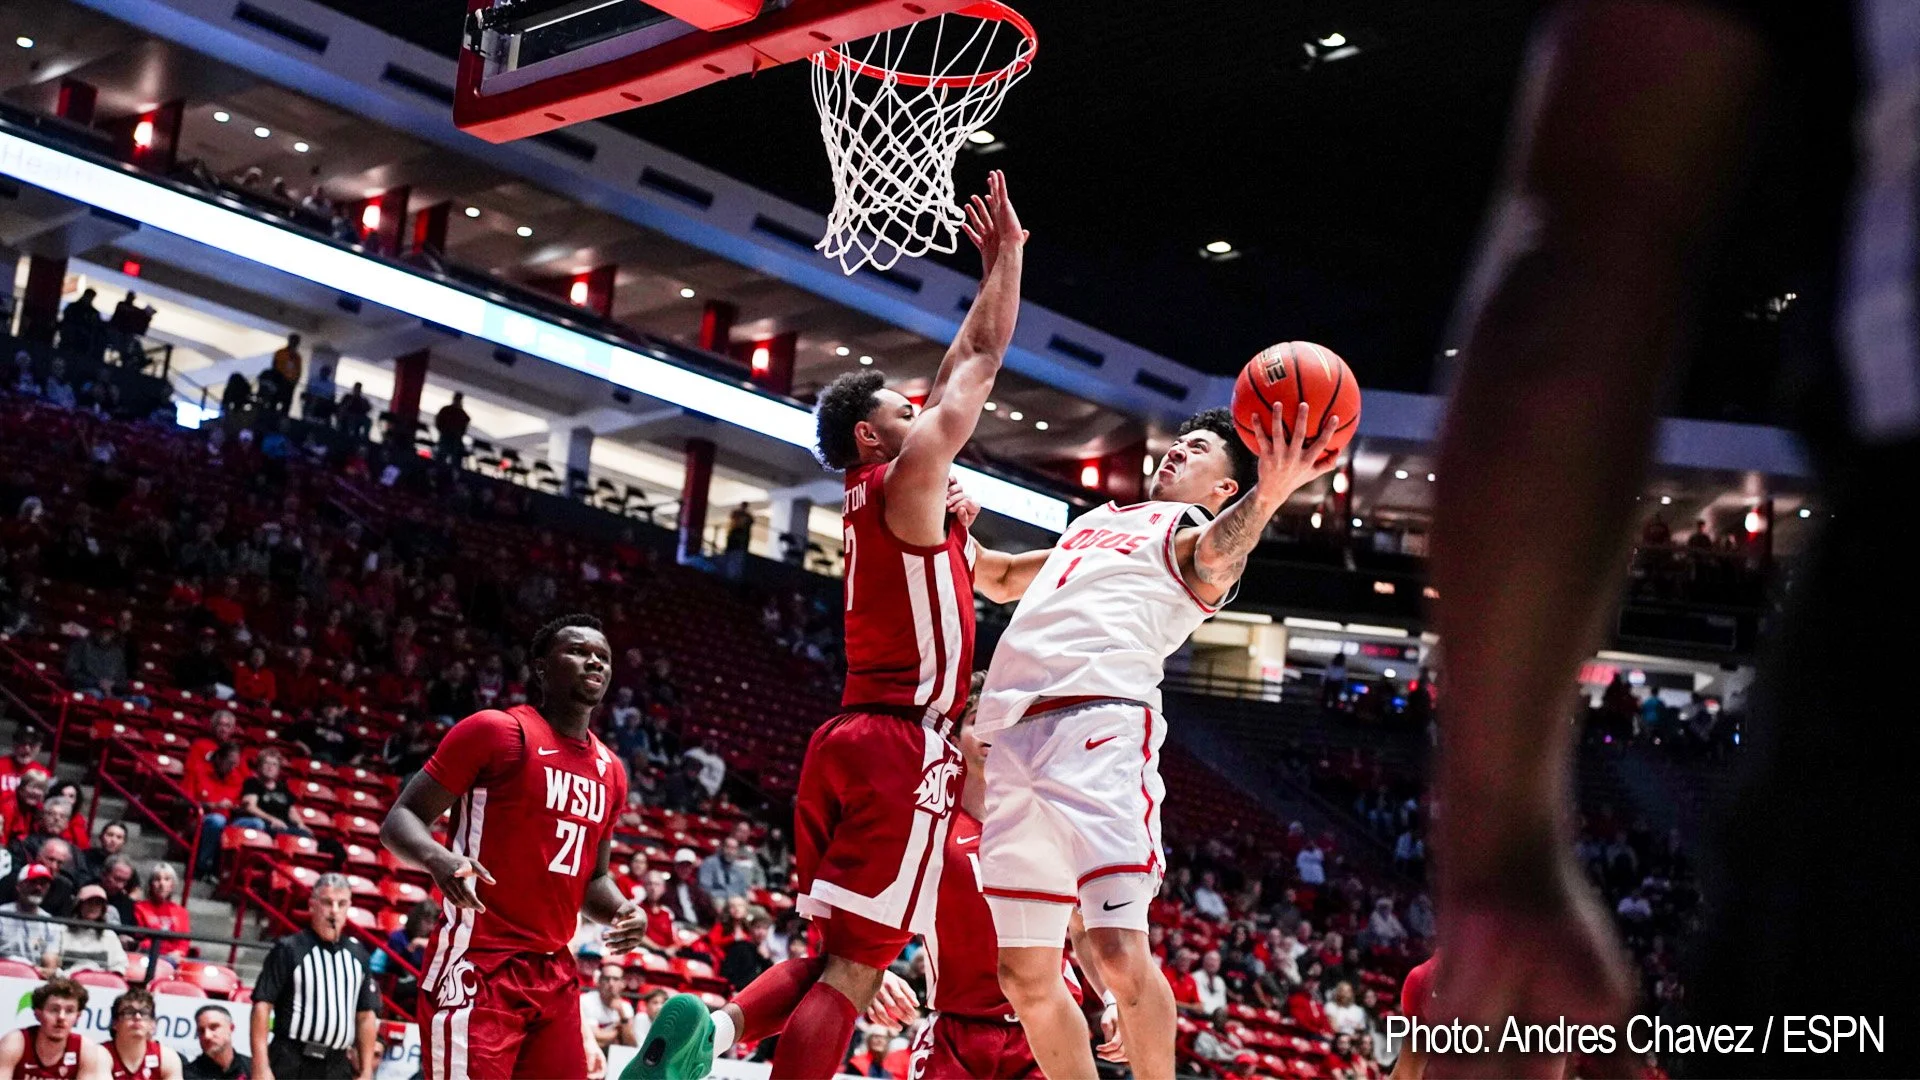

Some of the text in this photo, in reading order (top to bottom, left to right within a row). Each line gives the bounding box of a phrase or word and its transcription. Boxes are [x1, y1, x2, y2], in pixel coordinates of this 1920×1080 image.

[1061, 528, 1150, 555] OBOS
[544, 766, 606, 824] WSU
[548, 819, 588, 877] 21
